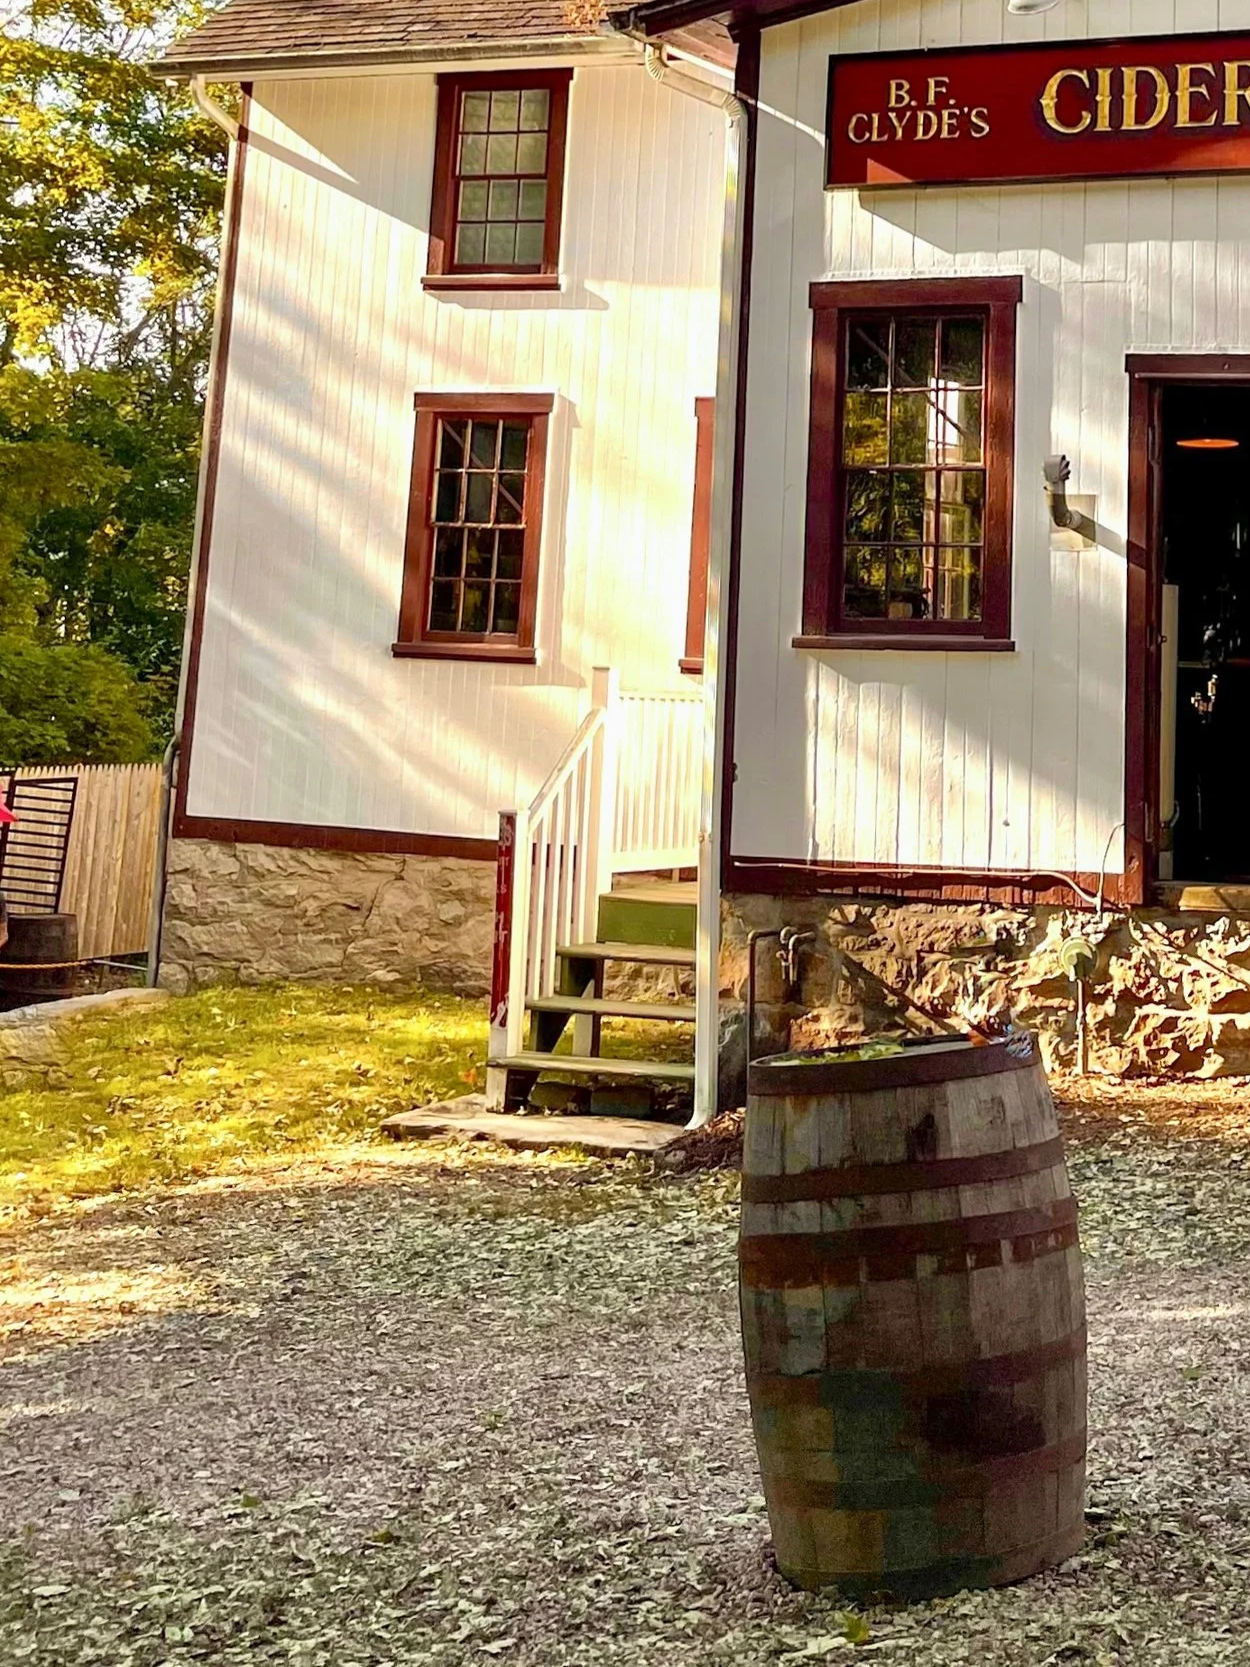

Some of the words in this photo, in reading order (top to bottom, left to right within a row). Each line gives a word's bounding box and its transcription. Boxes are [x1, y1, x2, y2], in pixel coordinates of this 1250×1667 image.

[888, 79, 918, 108] B.
[927, 76, 957, 106] F.
[847, 107, 990, 143] CLYDE'S
